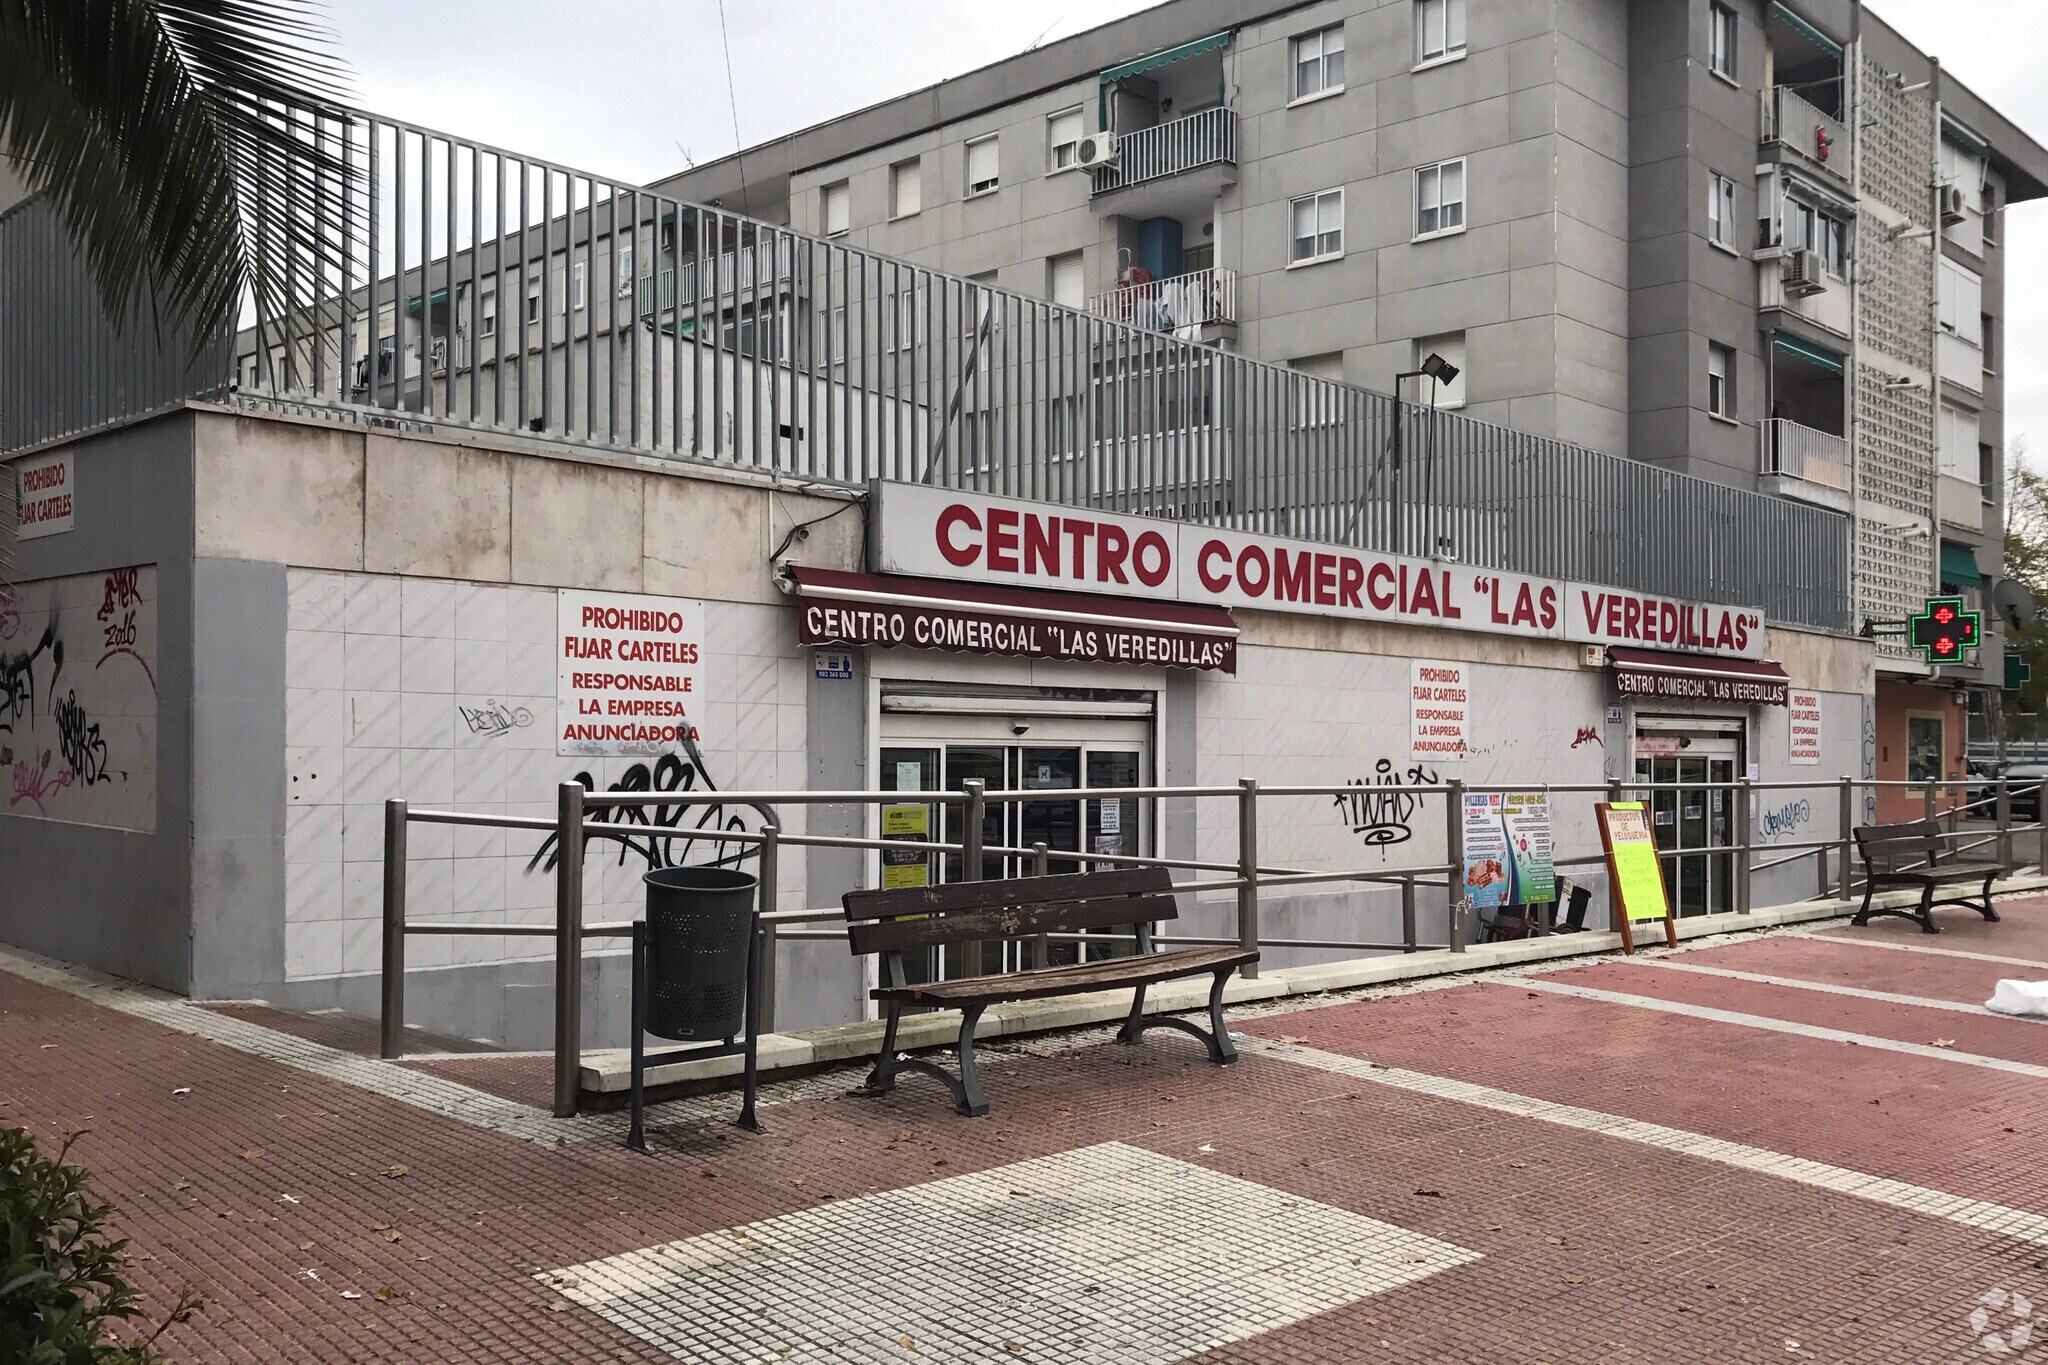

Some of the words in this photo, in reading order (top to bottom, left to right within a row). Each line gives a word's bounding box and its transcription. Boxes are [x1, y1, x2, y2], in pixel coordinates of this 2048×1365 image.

[24, 463, 65, 492] PROHIBIDO
[37, 494, 71, 521] CARTELES
[936, 504, 1171, 586] CENTRO
[1197, 539, 1461, 619] COMERCIAL
[1474, 576, 1556, 629] "LAS
[1582, 591, 1758, 652] VEREDILLAS"
[582, 606, 683, 633] PROHIBIDO
[806, 606, 905, 641] CENTRO
[914, 615, 1042, 652] COMERCIAL
[1047, 625, 1098, 656] "LAS
[1105, 633, 1234, 666] VEREDILLAS"
[564, 636, 612, 660] FIJAR
[617, 639, 699, 664] CARTELES
[572, 672, 692, 693] RESPONSABLE
[1419, 667, 1460, 684] PROHIBIDO
[1413, 686, 1432, 701] FIJAR
[1433, 688, 1467, 703] CARTELES
[1617, 673, 1655, 694] CENTRO
[1657, 676, 1708, 697] COMERCIAL
[1709, 679, 1730, 699] "LAS
[1732, 683, 1787, 702] VEREDILLAS"
[579, 699, 602, 715] LA
[608, 700, 685, 717] EMPRESA
[1793, 694, 1817, 708] PROHIBIDO
[1416, 709, 1464, 721] RESPONSABLE
[1802, 710, 1820, 722] CARTELES
[563, 724, 700, 742] ANUNCIADORA
[1418, 725, 1428, 736] LA
[1430, 726, 1461, 737] EMPRESA
[1792, 726, 1819, 736] RESPONSABLE
[1412, 741, 1468, 753] ANUNCIADORA
[1799, 738, 1817, 747] EMPRESA
[1791, 749, 1820, 759] ANUNCIADORA
